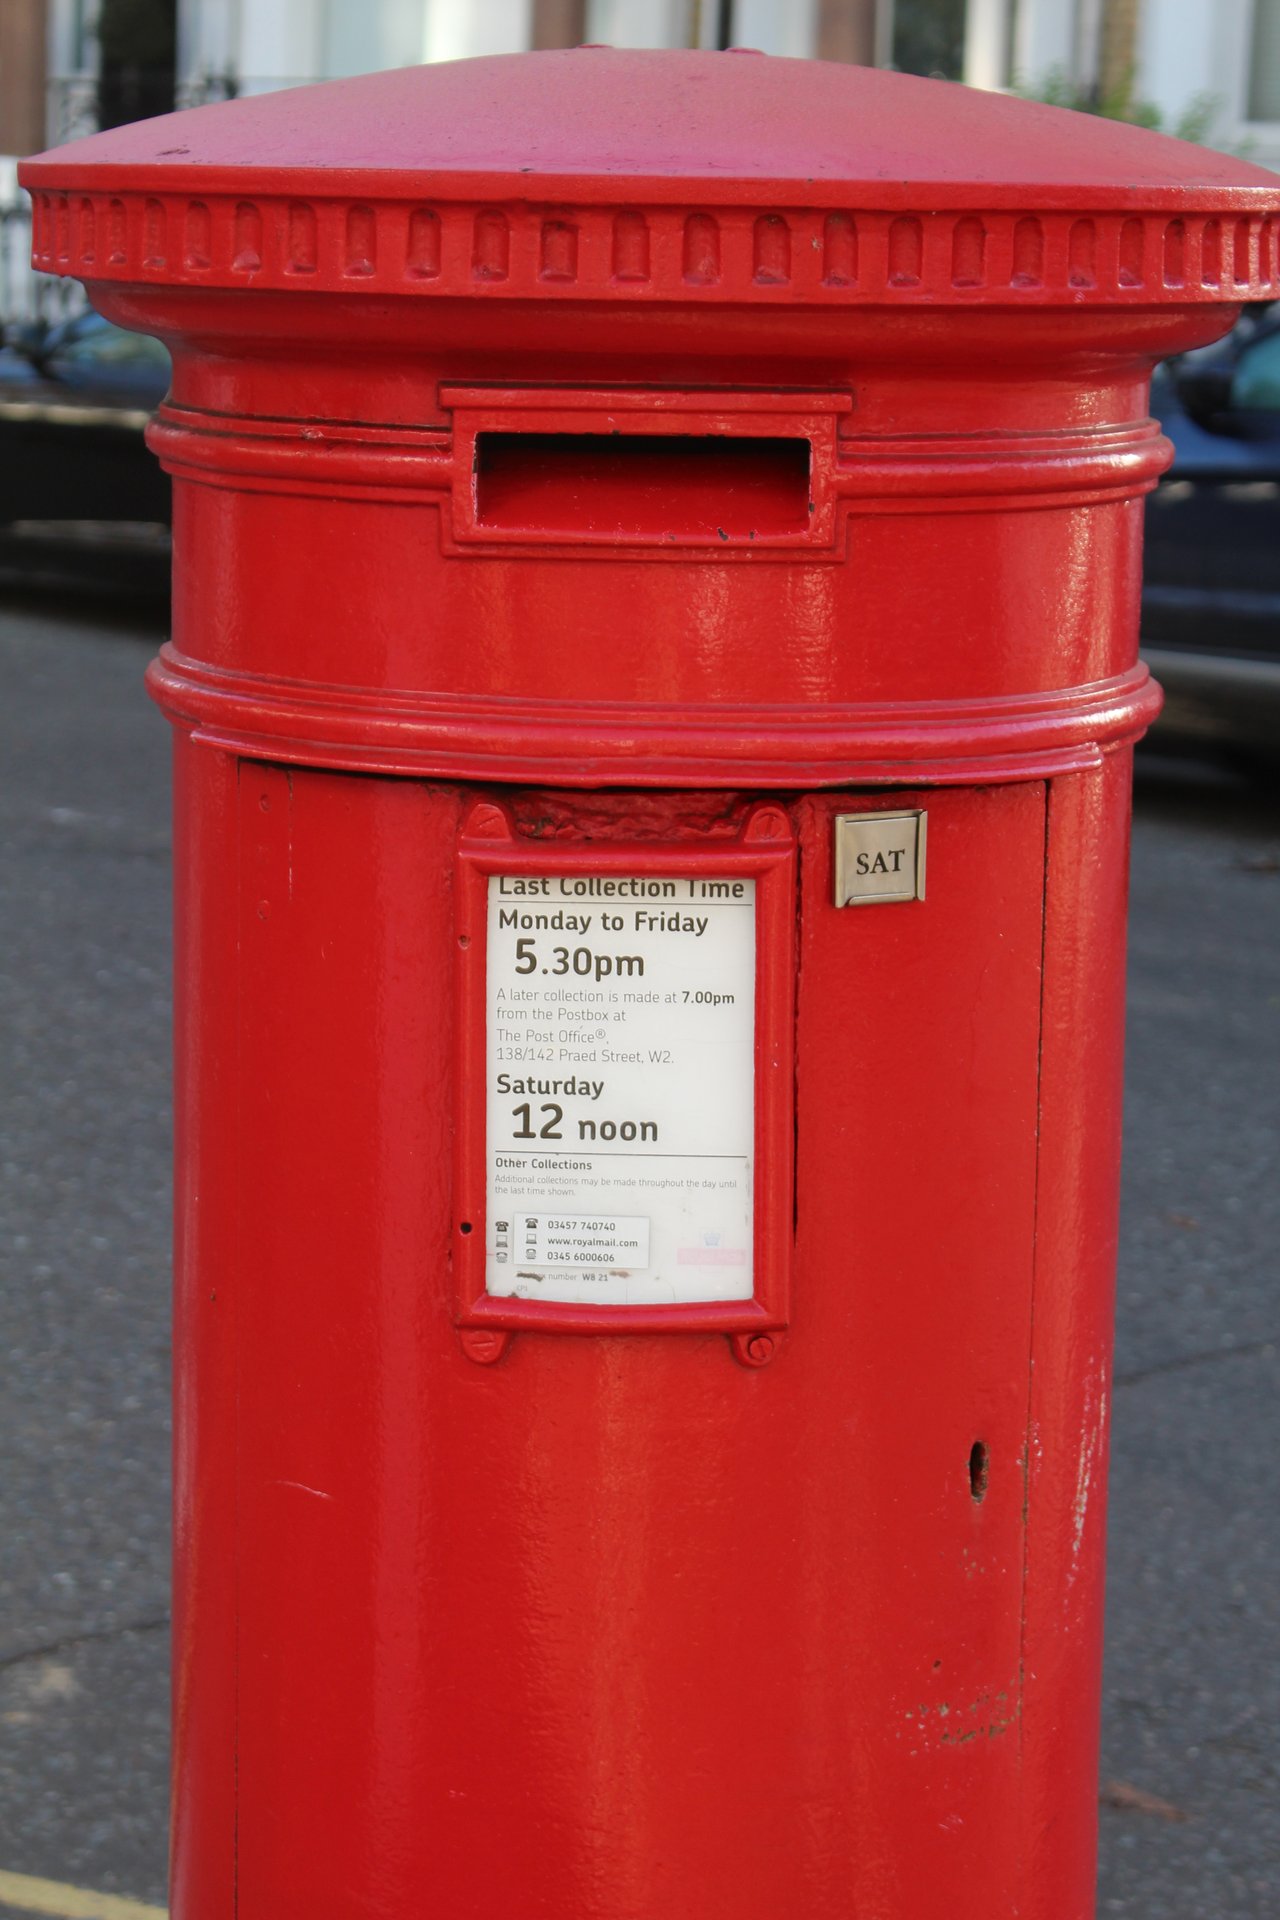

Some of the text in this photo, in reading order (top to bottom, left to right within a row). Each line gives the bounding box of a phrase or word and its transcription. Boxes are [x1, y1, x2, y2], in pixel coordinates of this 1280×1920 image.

[856, 849, 905, 875] SAT
[500, 877, 745, 898] Last Collection Time
[499, 909, 709, 936] Monday to Friday
[515, 938, 645, 982] 5.30pm
[497, 988, 735, 1006] A later collection is made at 7.00pm
[497, 1006, 626, 1021] from the Postbox at
[496, 1028, 521, 1042] The
[526, 1029, 554, 1042] Post
[496, 1047, 674, 1063] 138/142 Praed Street, W2.
[496, 1074, 604, 1100] Saturday
[512, 1103, 658, 1142] 12 noon
[495, 1157, 592, 1170] Other Collections
[495, 1174, 737, 1189] Additional collections may be made throughout the day until
[495, 1186, 508, 1194] the
[510, 1186, 525, 1195] last
[527, 1187, 546, 1196] time
[547, 1221, 616, 1232] 03457 740740
[547, 1236, 638, 1249] www.royalmail.com
[547, 1251, 615, 1263] 0345 6000606
[548, 1272, 577, 1281] number
[582, 1273, 596, 1282] W8
[599, 1274, 609, 1282] 21
